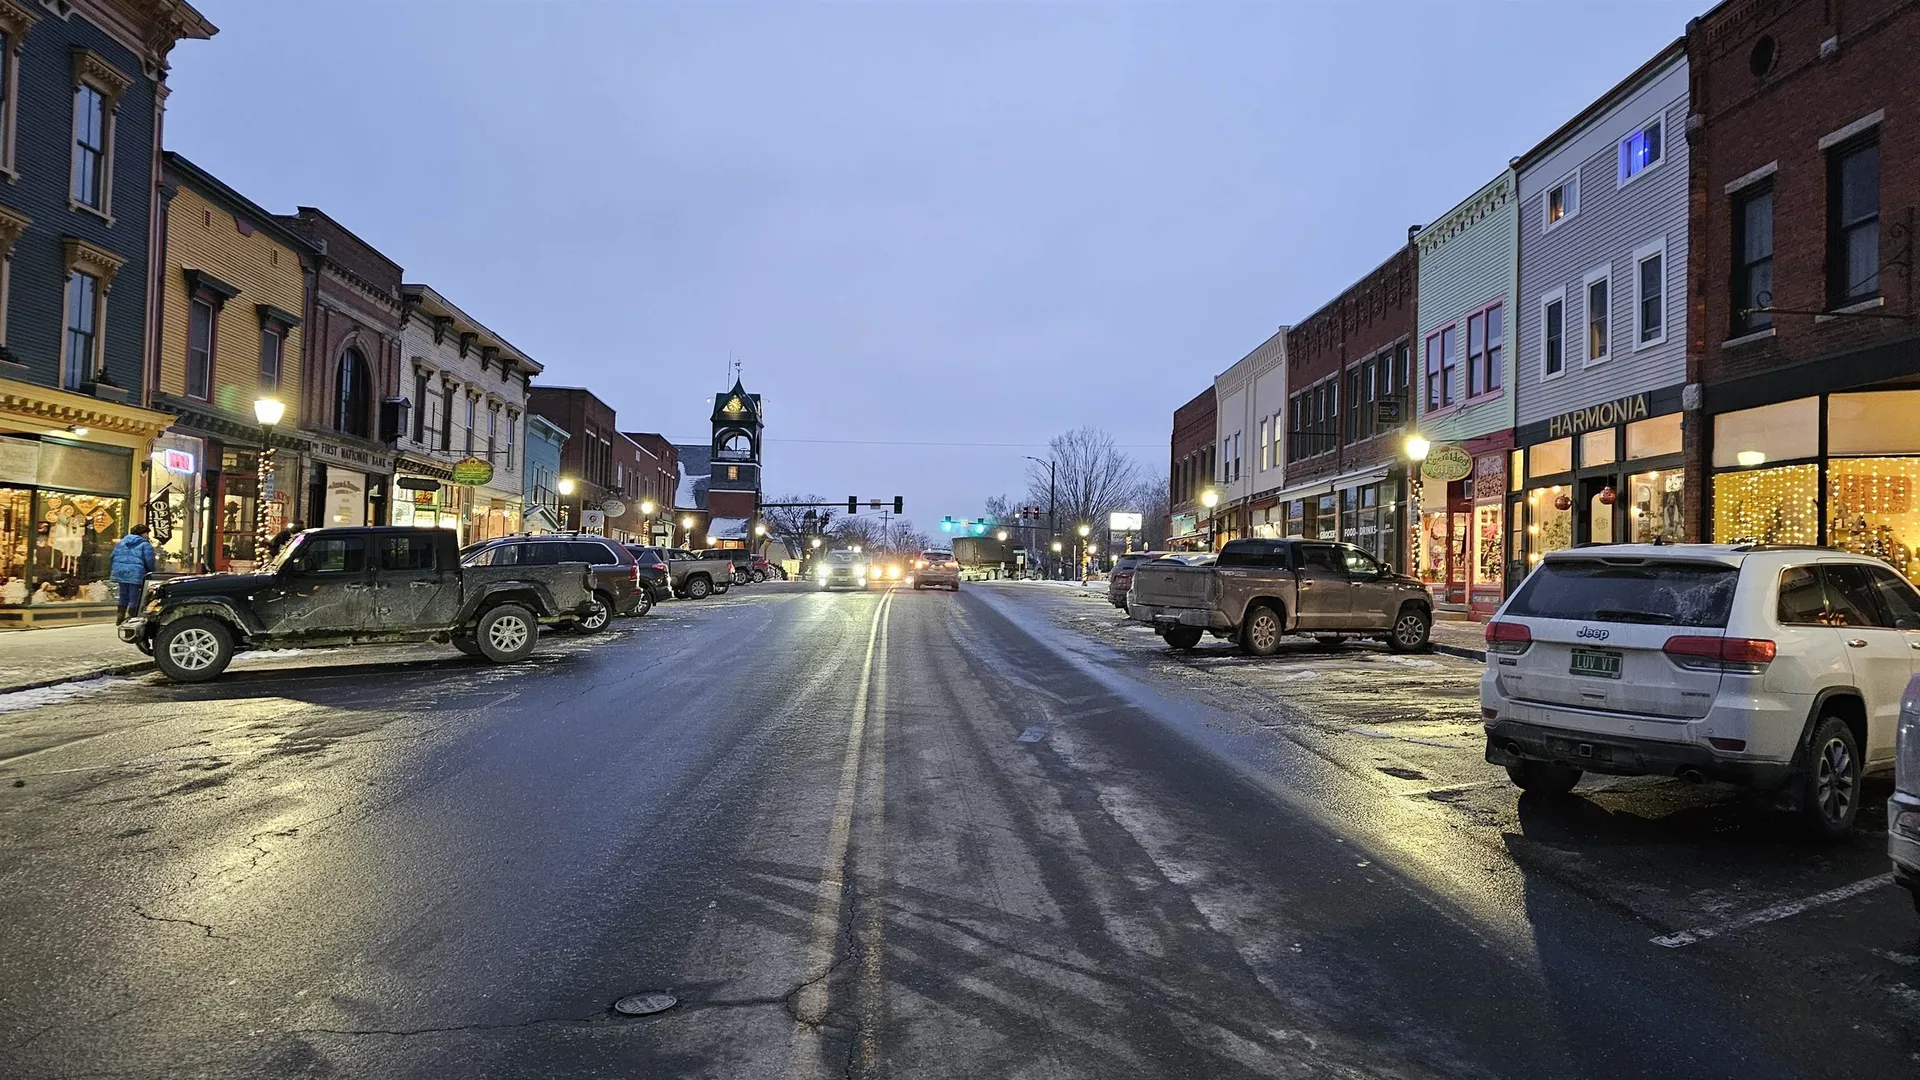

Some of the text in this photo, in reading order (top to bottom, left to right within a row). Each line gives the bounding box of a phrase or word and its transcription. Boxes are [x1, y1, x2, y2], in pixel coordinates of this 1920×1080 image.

[1549, 394, 1648, 438] HARMONIA
[321, 443, 386, 467] FIRST NATIONAL BANK
[152, 501, 169, 538] OPEN
[1576, 626, 1609, 641] Jeep
[1577, 655, 1614, 671] LUV VT
